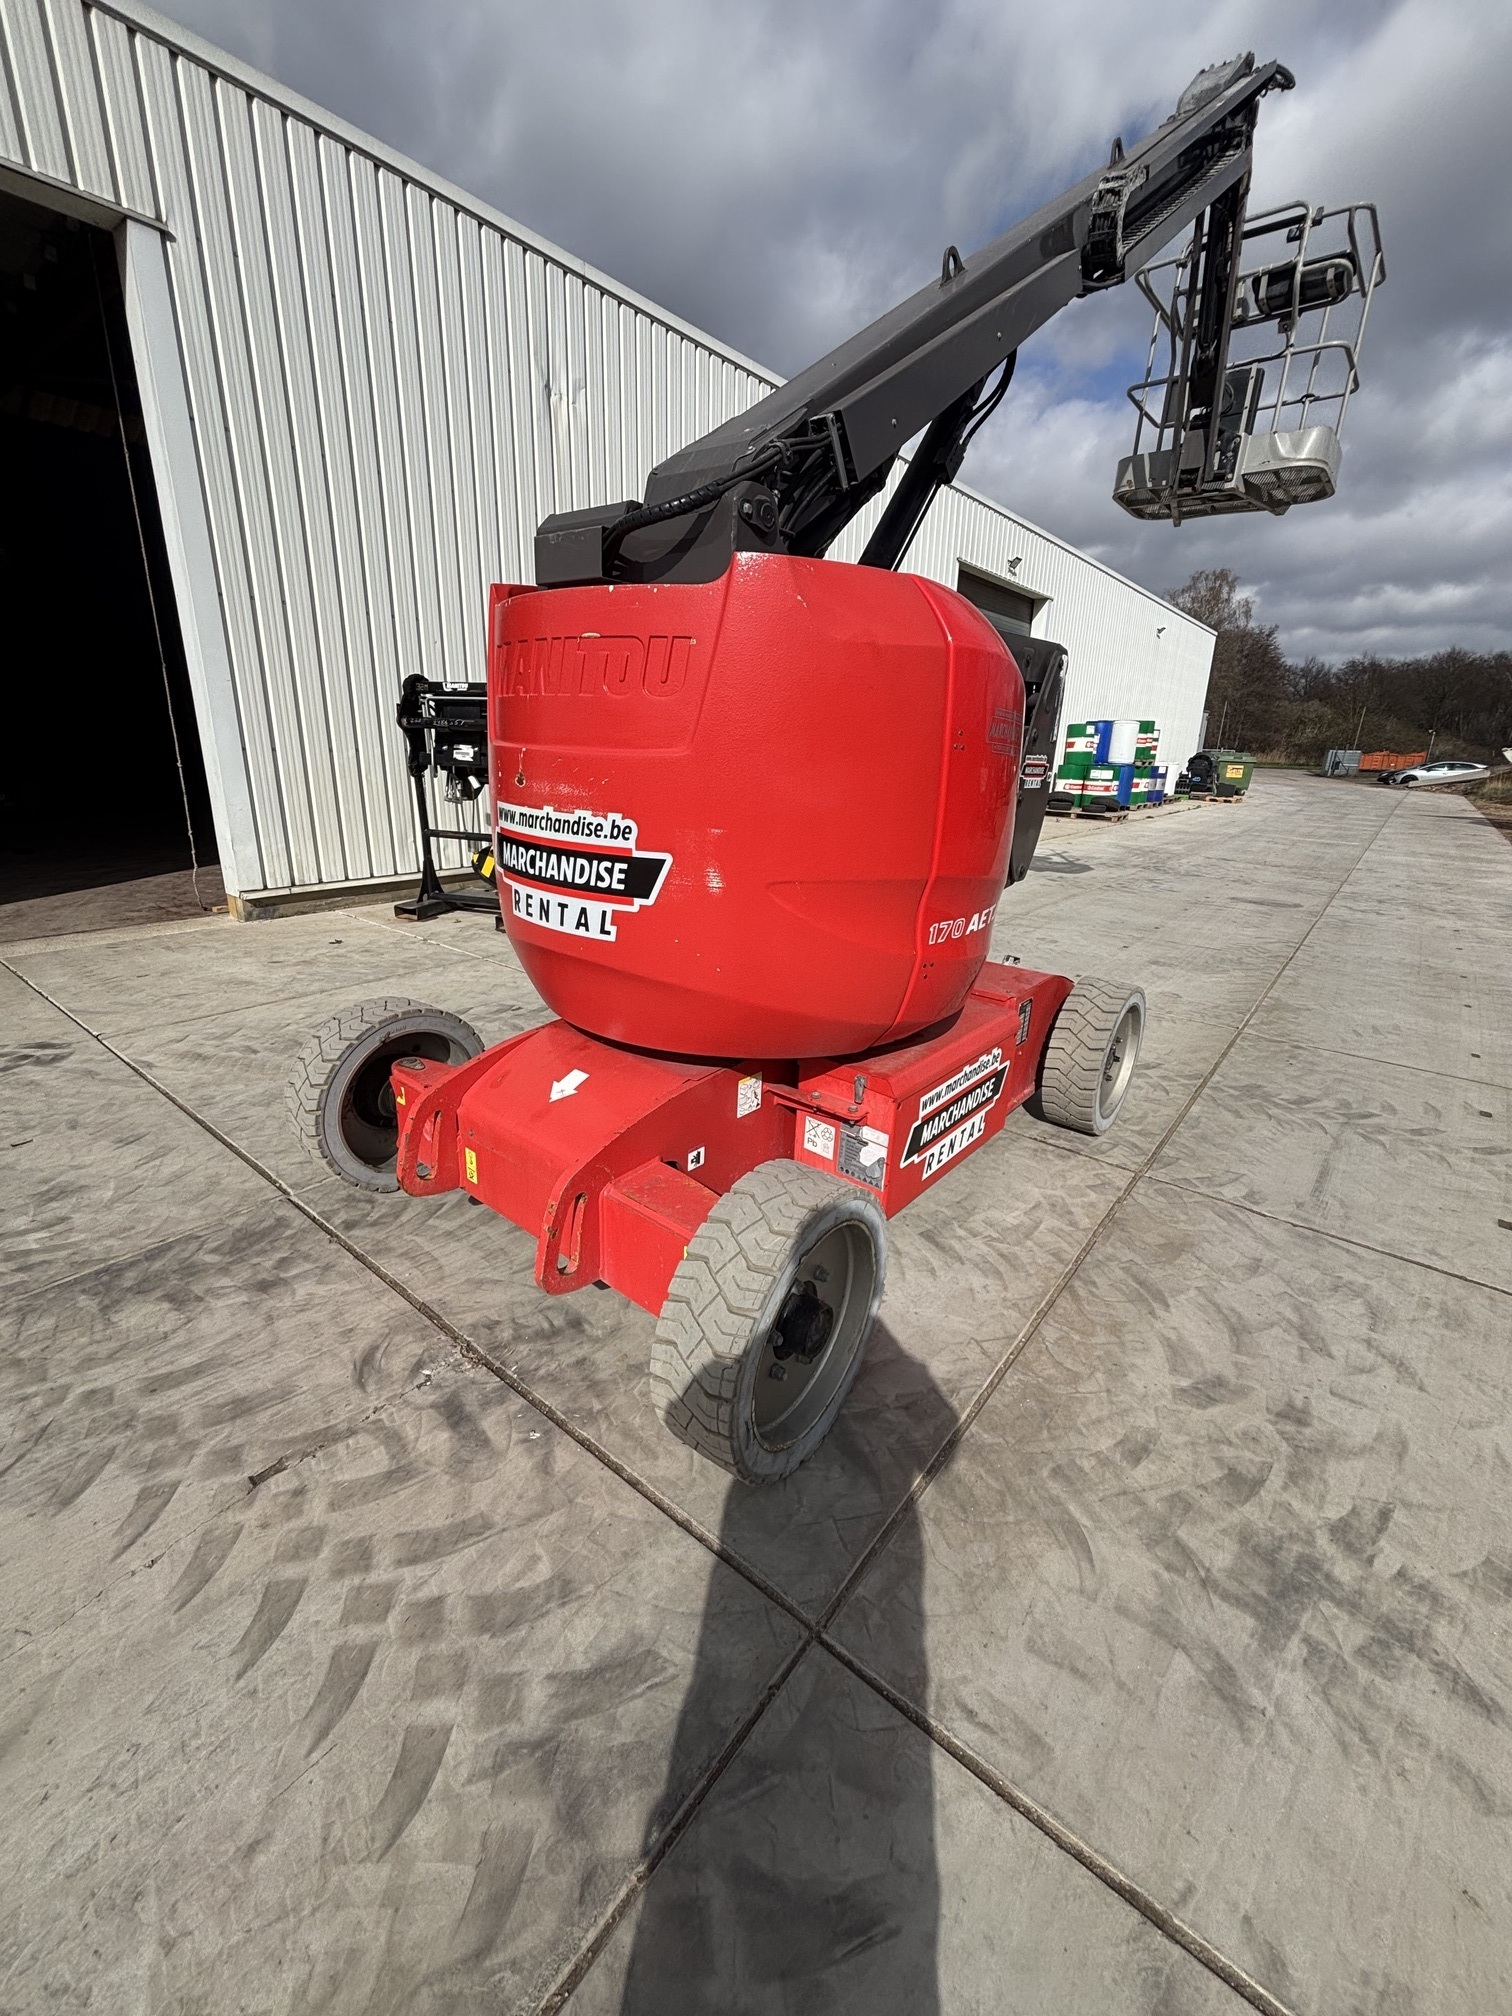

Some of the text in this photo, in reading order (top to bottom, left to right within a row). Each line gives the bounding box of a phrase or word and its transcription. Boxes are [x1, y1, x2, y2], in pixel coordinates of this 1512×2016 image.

[499, 806, 632, 841] www.marchandise.be
[502, 841, 628, 890] MARCHANDISE
[514, 889, 611, 936] RENTAL
[928, 917, 966, 945] 170
[921, 1052, 1001, 1112] www.marchandise.be
[920, 1077, 996, 1147] MARCHANDISE
[807, 1137, 818, 1148] Pb
[925, 1115, 984, 1175] RENTAL
